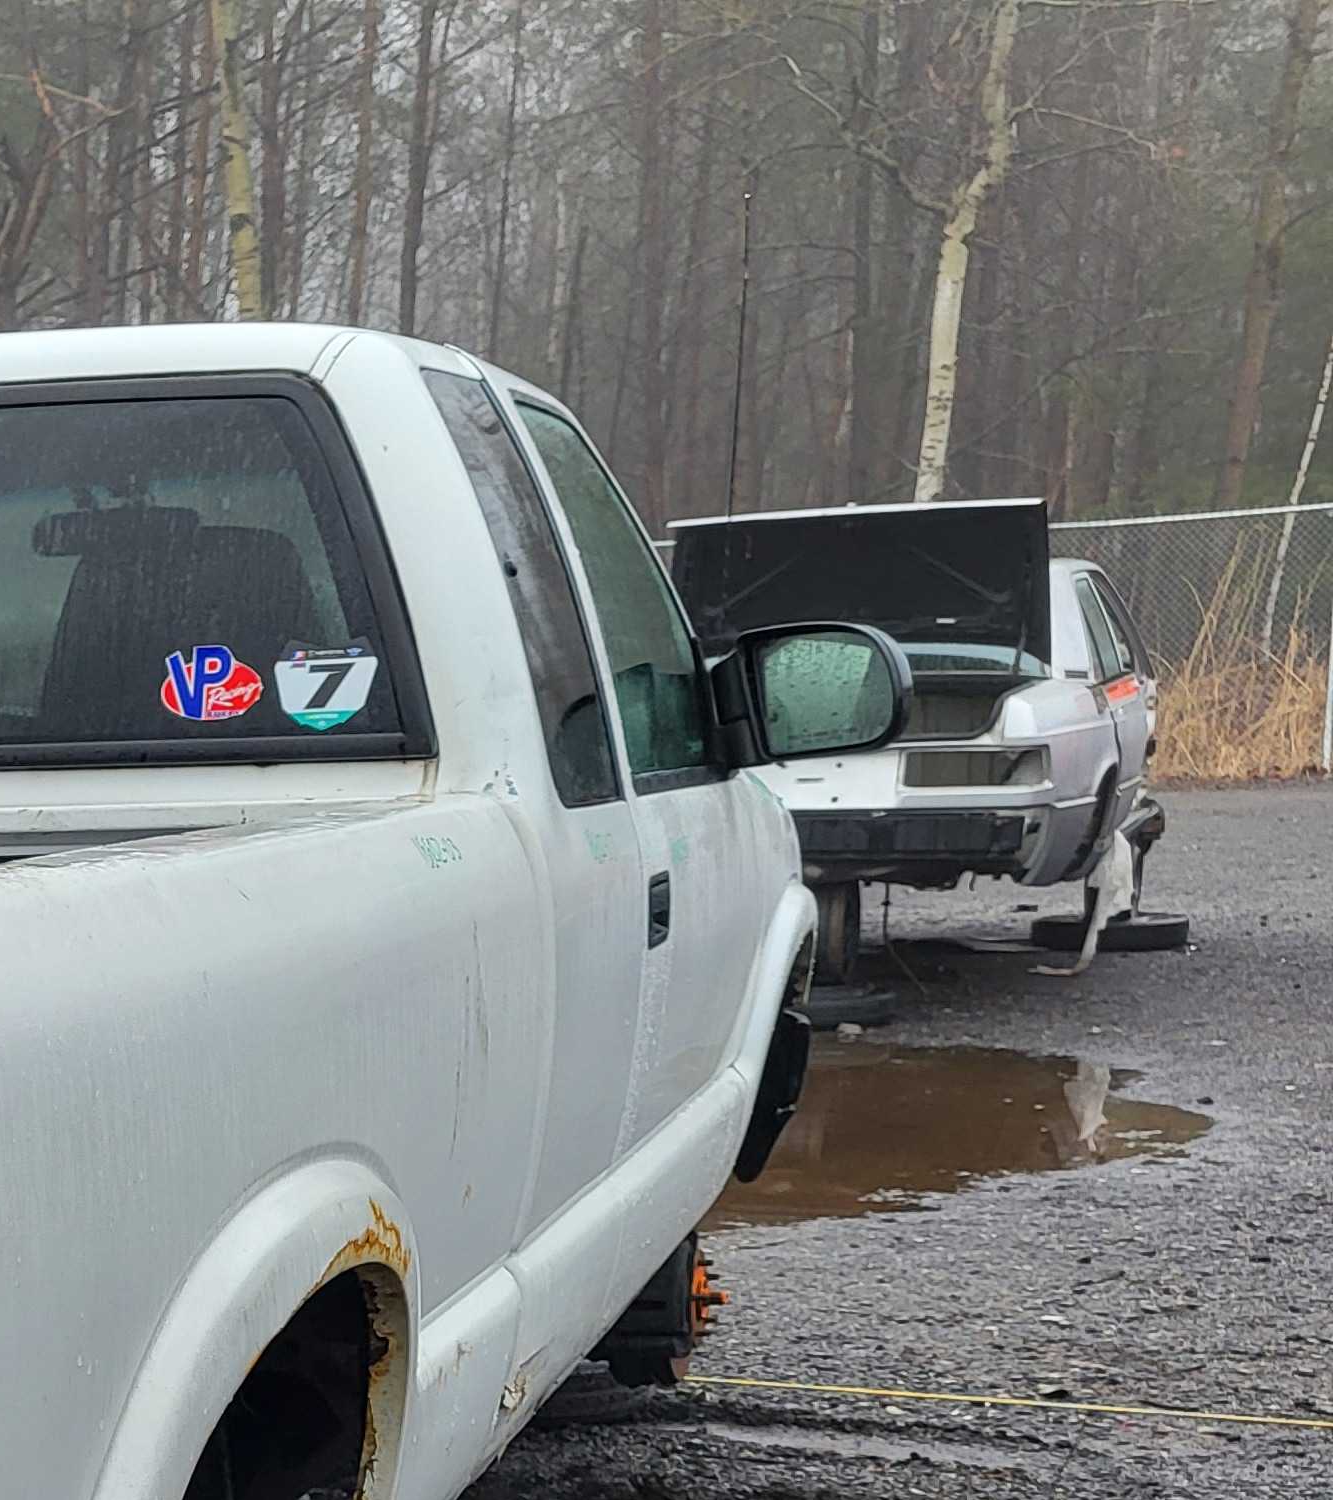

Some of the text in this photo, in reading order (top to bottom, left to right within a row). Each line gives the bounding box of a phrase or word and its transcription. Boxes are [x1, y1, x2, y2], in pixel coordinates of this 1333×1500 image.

[165, 645, 234, 720] VP
[206, 681, 264, 711] Racing
[304, 662, 356, 709] 7
